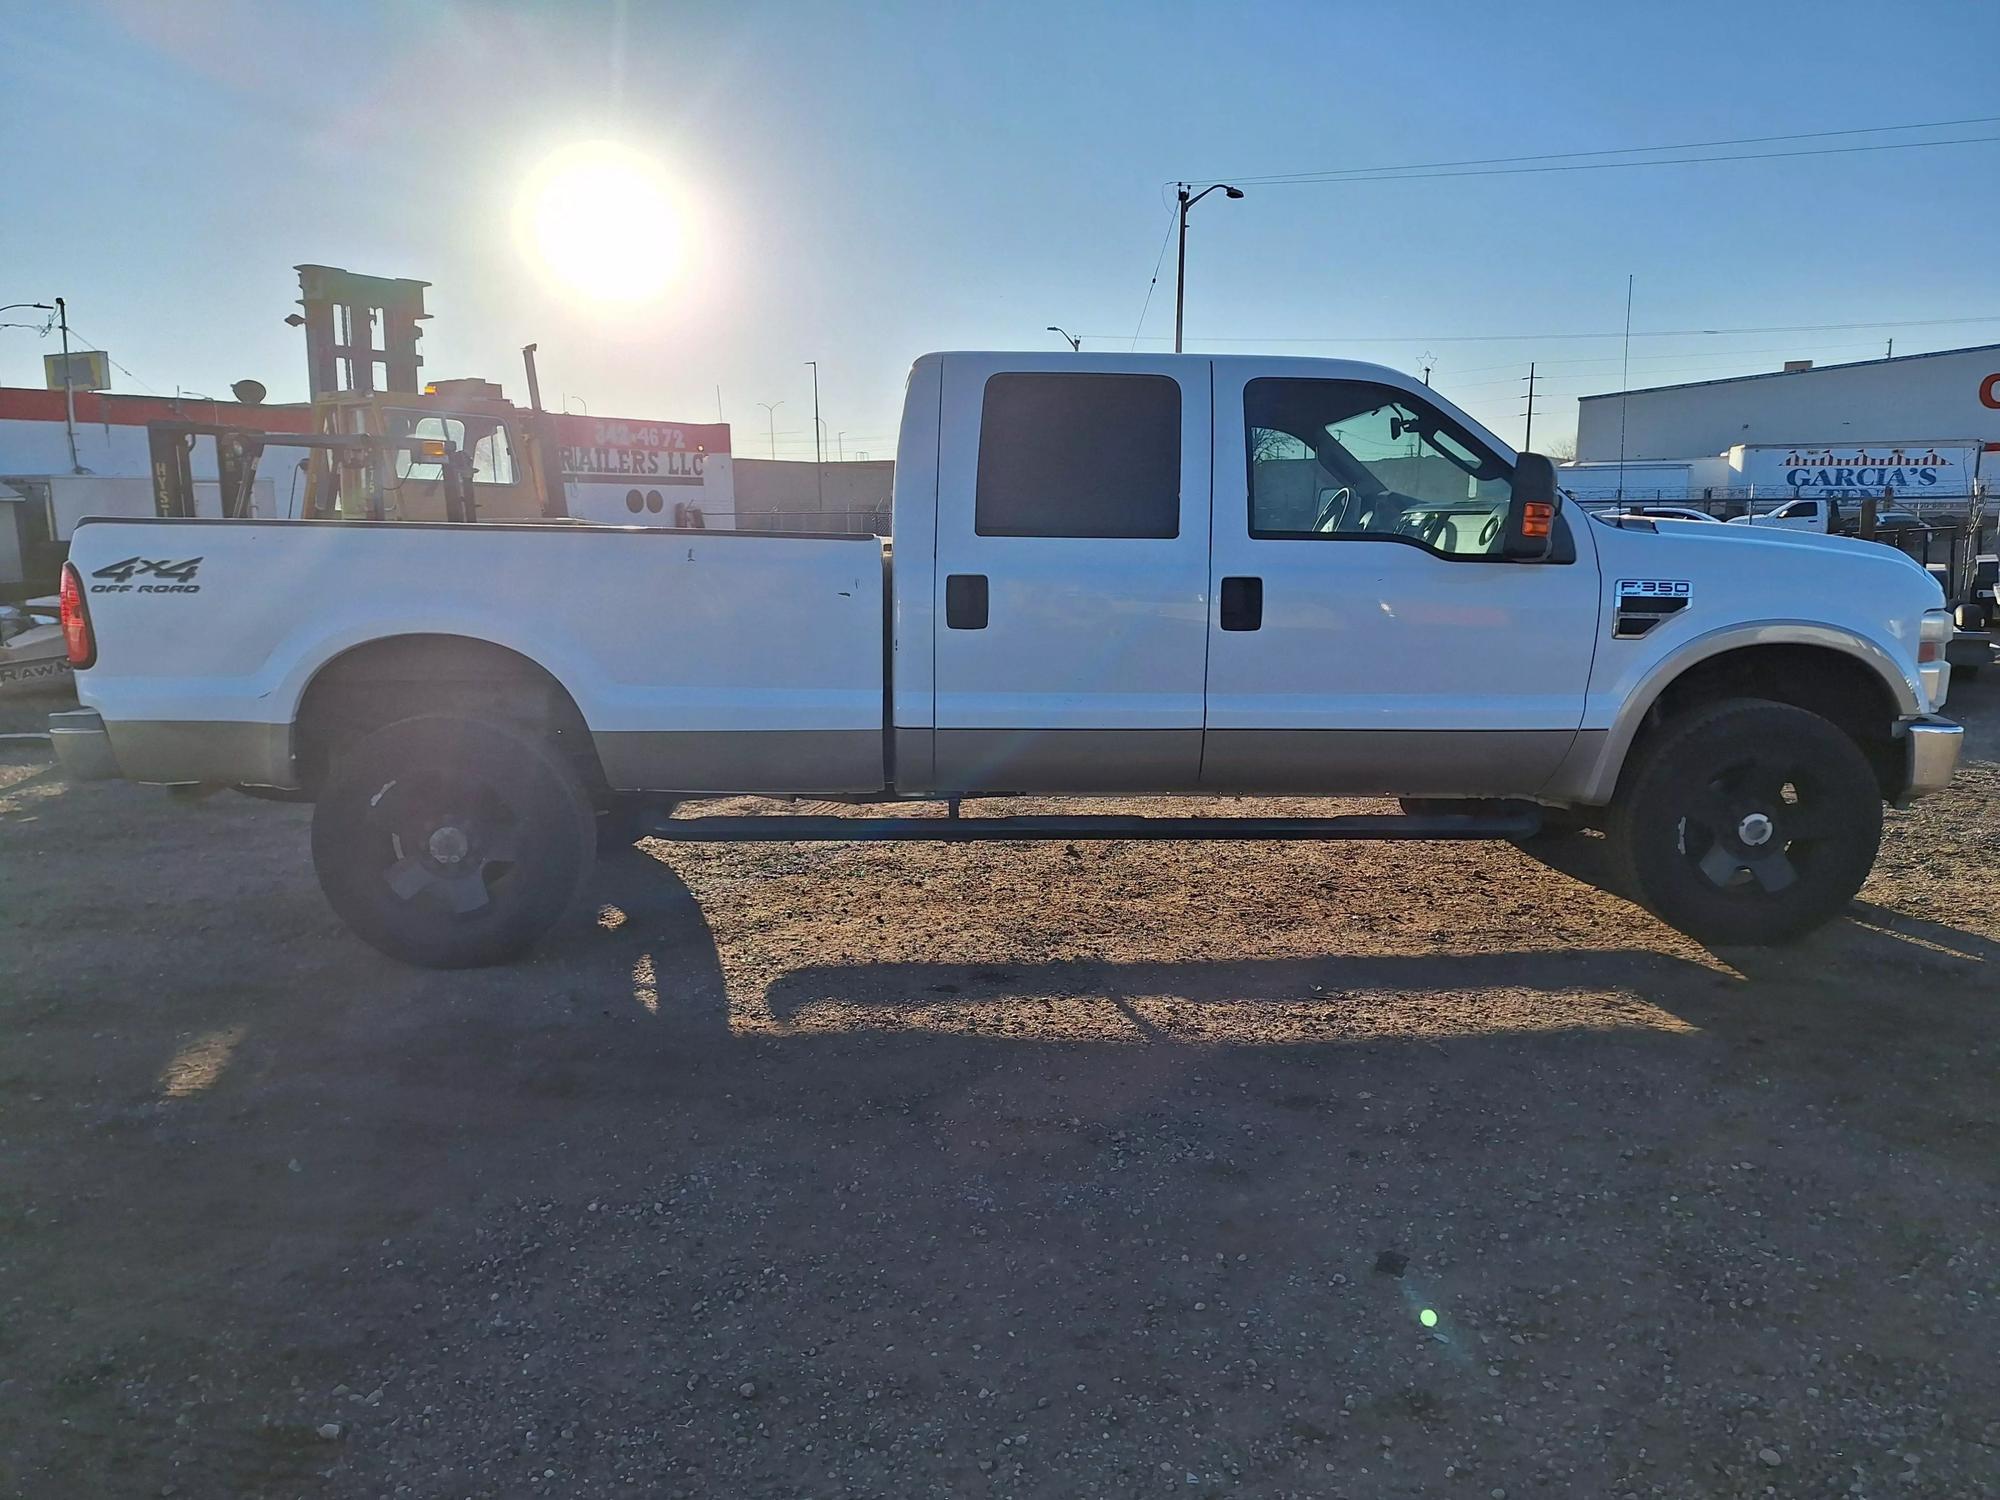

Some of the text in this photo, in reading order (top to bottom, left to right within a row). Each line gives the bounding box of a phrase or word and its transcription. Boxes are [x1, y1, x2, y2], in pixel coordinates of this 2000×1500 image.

[668, 452, 704, 475] LLC
[1786, 467, 1937, 487] GARCIA'S
[91, 584, 200, 593] OFF ROAD
